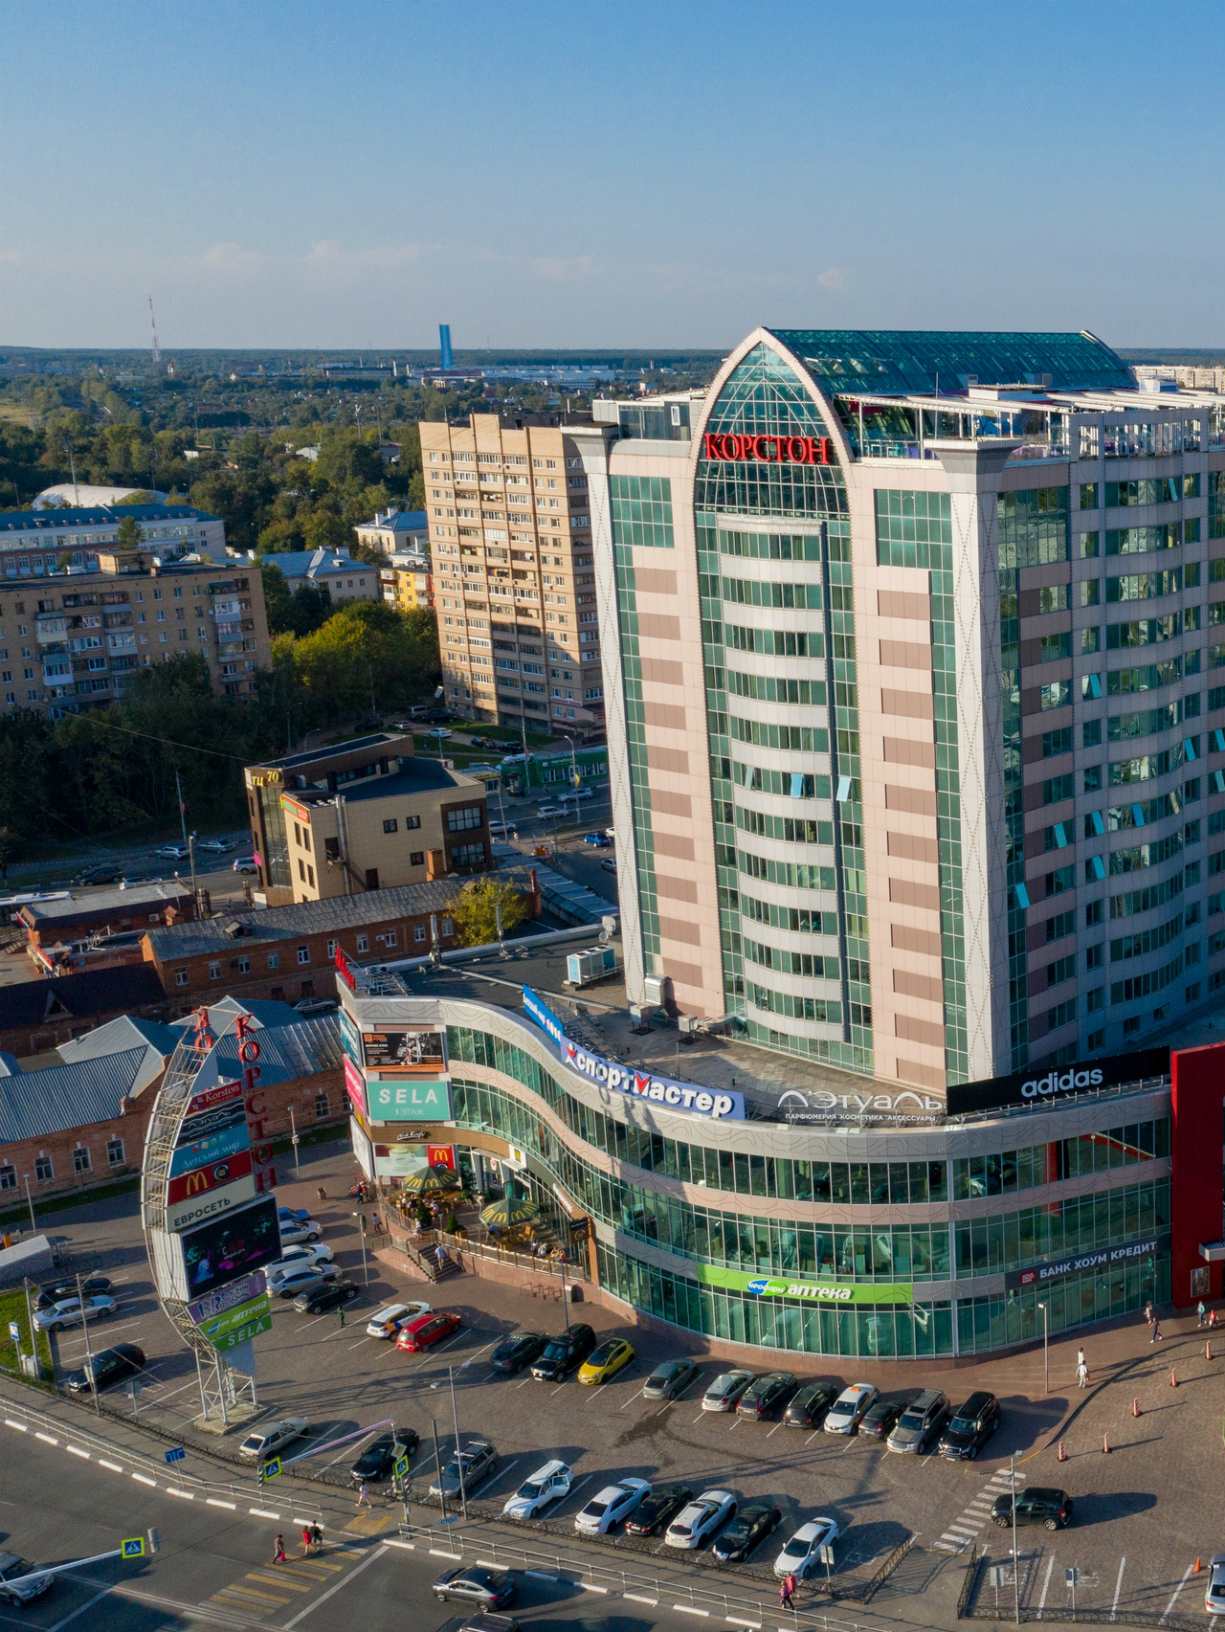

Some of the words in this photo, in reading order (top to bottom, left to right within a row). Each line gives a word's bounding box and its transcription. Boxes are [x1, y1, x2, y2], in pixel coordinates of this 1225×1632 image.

[704, 433, 829, 464] КОРСТОН
[378, 1088, 438, 1104] SELA
[1021, 1068, 1103, 1098] adidas
[173, 1199, 231, 1227] ЕВРОСЕТЬ
[1039, 1262, 1072, 1280] БАНК
[1074, 1254, 1108, 1271] ХОУМ
[1110, 1240, 1158, 1262] КРЕДИТ
[788, 1283, 852, 1300] аптека
[227, 1322, 265, 1347] SELA
